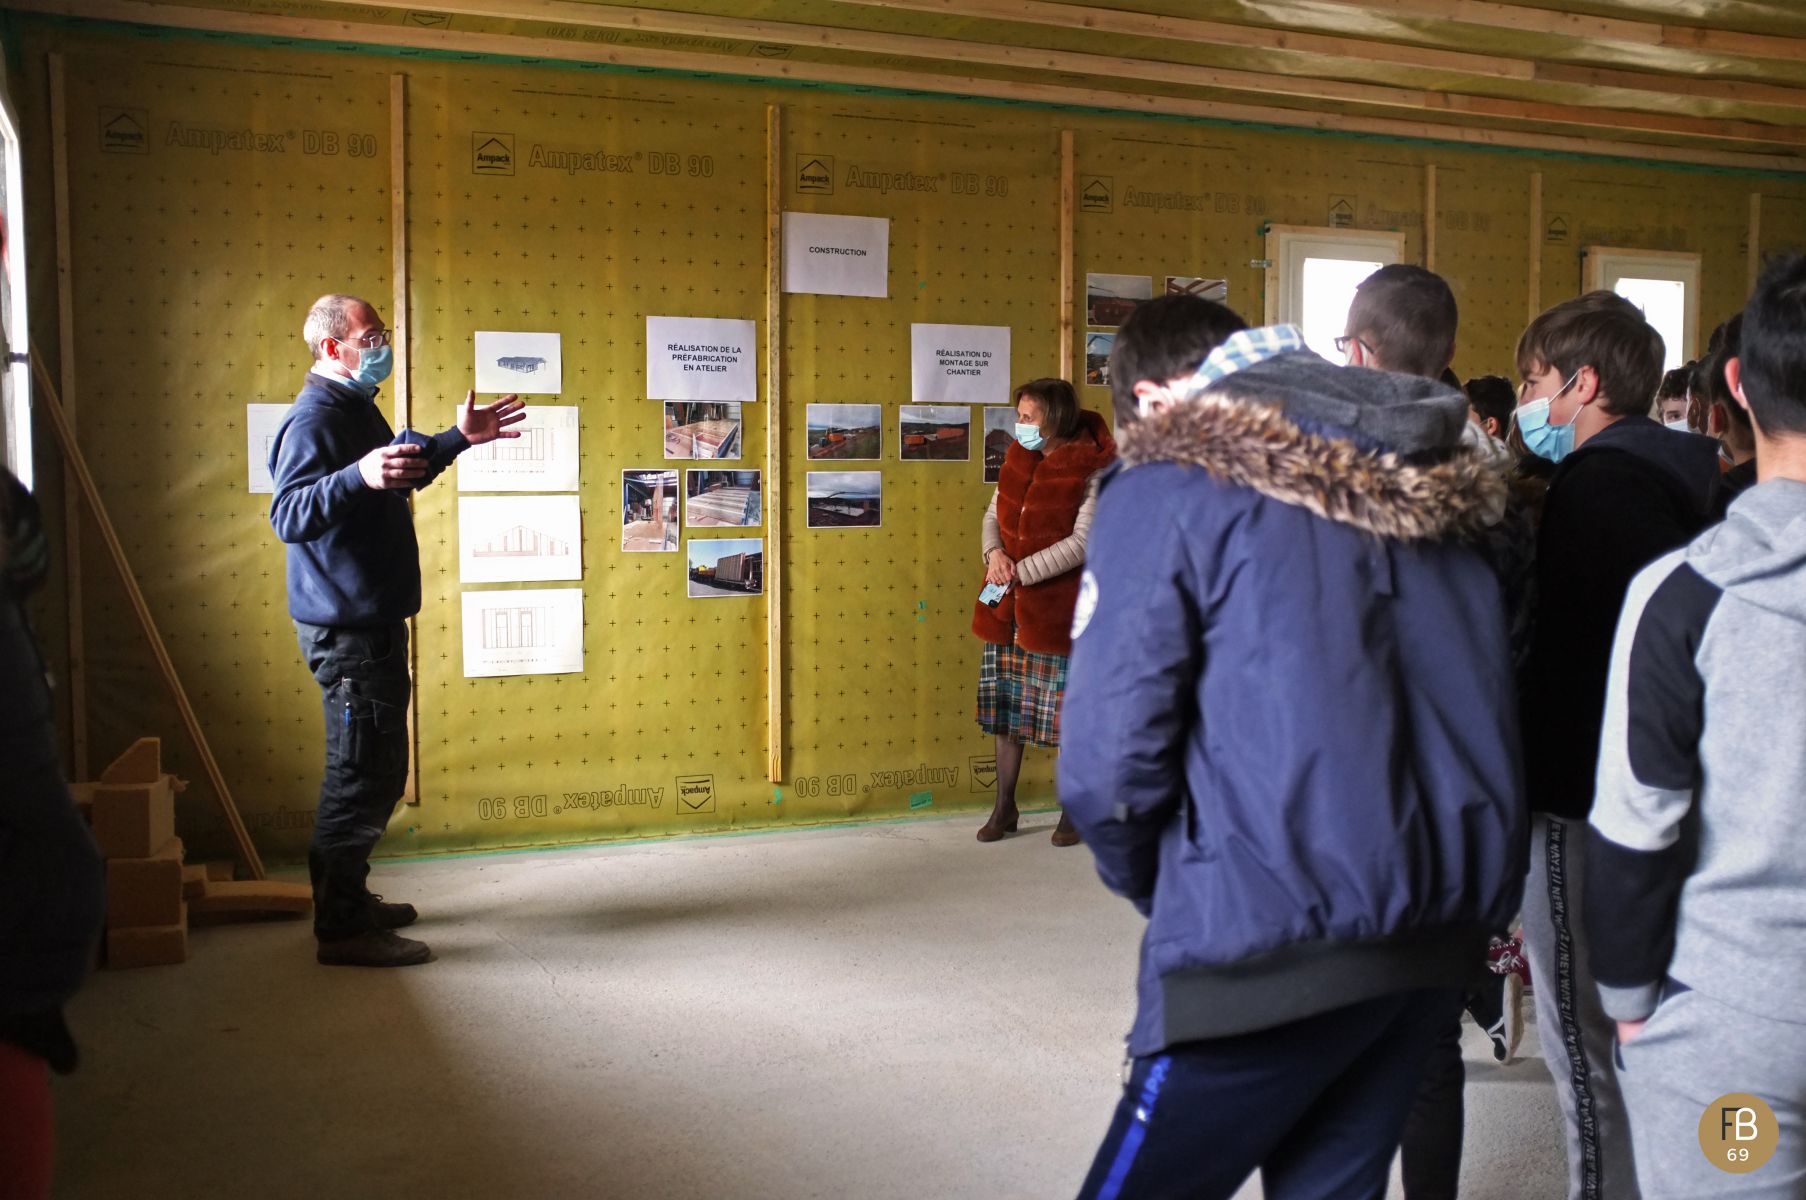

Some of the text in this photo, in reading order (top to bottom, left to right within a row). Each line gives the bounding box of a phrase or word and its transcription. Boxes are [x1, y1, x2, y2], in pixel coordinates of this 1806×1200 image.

[302, 129, 340, 155] DB
[347, 134, 378, 158] 90
[476, 152, 511, 164] Ampack
[648, 151, 682, 175] DB
[687, 154, 714, 177] 90
[799, 173, 830, 185] Ampack
[951, 172, 980, 195] DB
[985, 175, 1009, 197] 90
[808, 246, 867, 257] CONSTRUCTION
[667, 343, 719, 353] RÉALISATION
[936, 349, 981, 358] RÉALISATION
[672, 354, 738, 363] PRÉFABRICATION
[939, 359, 973, 367] MONTAGE
[695, 365, 727, 373] ATELIER
[946, 368, 981, 376] CHANTIER
[680, 785, 711, 796] Ampack
[795, 776, 820, 798] 90
[827, 774, 857, 796] DB
[478, 797, 506, 820] 90
[514, 795, 548, 818] DB
[1550, 822, 1562, 841] EW
